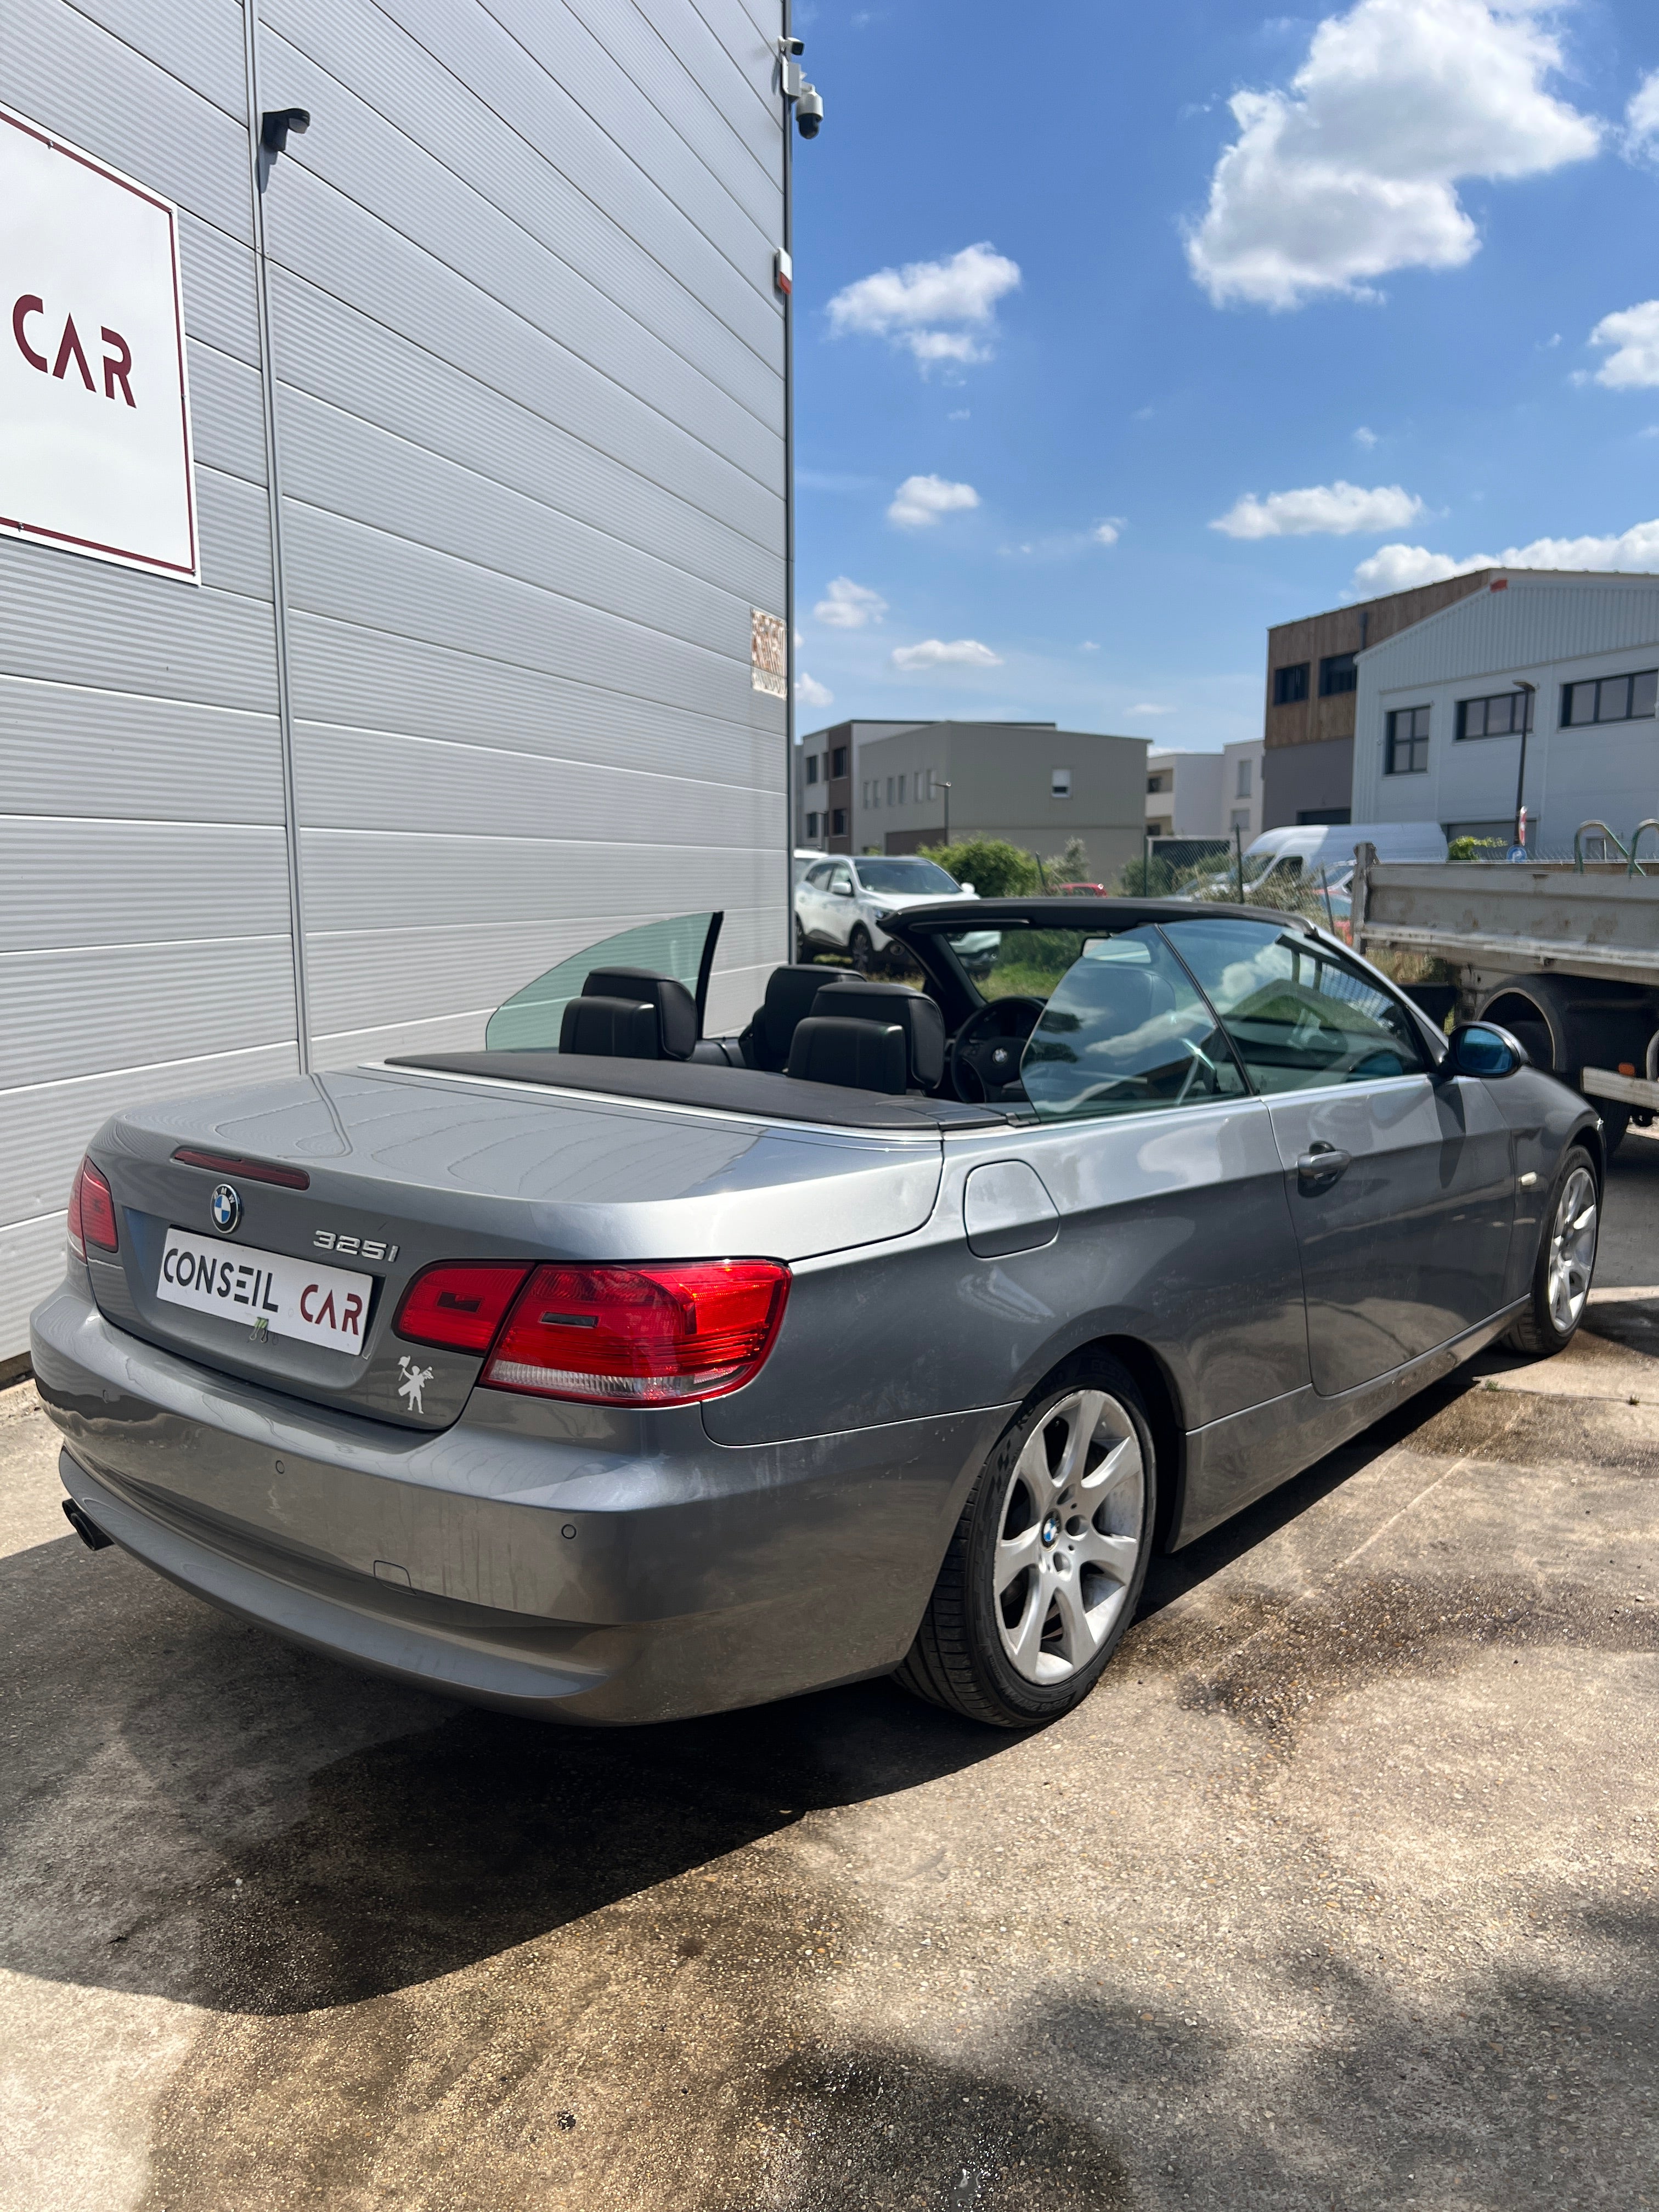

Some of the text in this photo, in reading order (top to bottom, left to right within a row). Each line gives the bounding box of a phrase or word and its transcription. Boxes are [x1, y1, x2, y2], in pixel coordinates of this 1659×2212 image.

[13, 294, 137, 409] CAR
[214, 1187, 236, 1204] BMW
[163, 1248, 363, 1336] CONSEIL CAR
